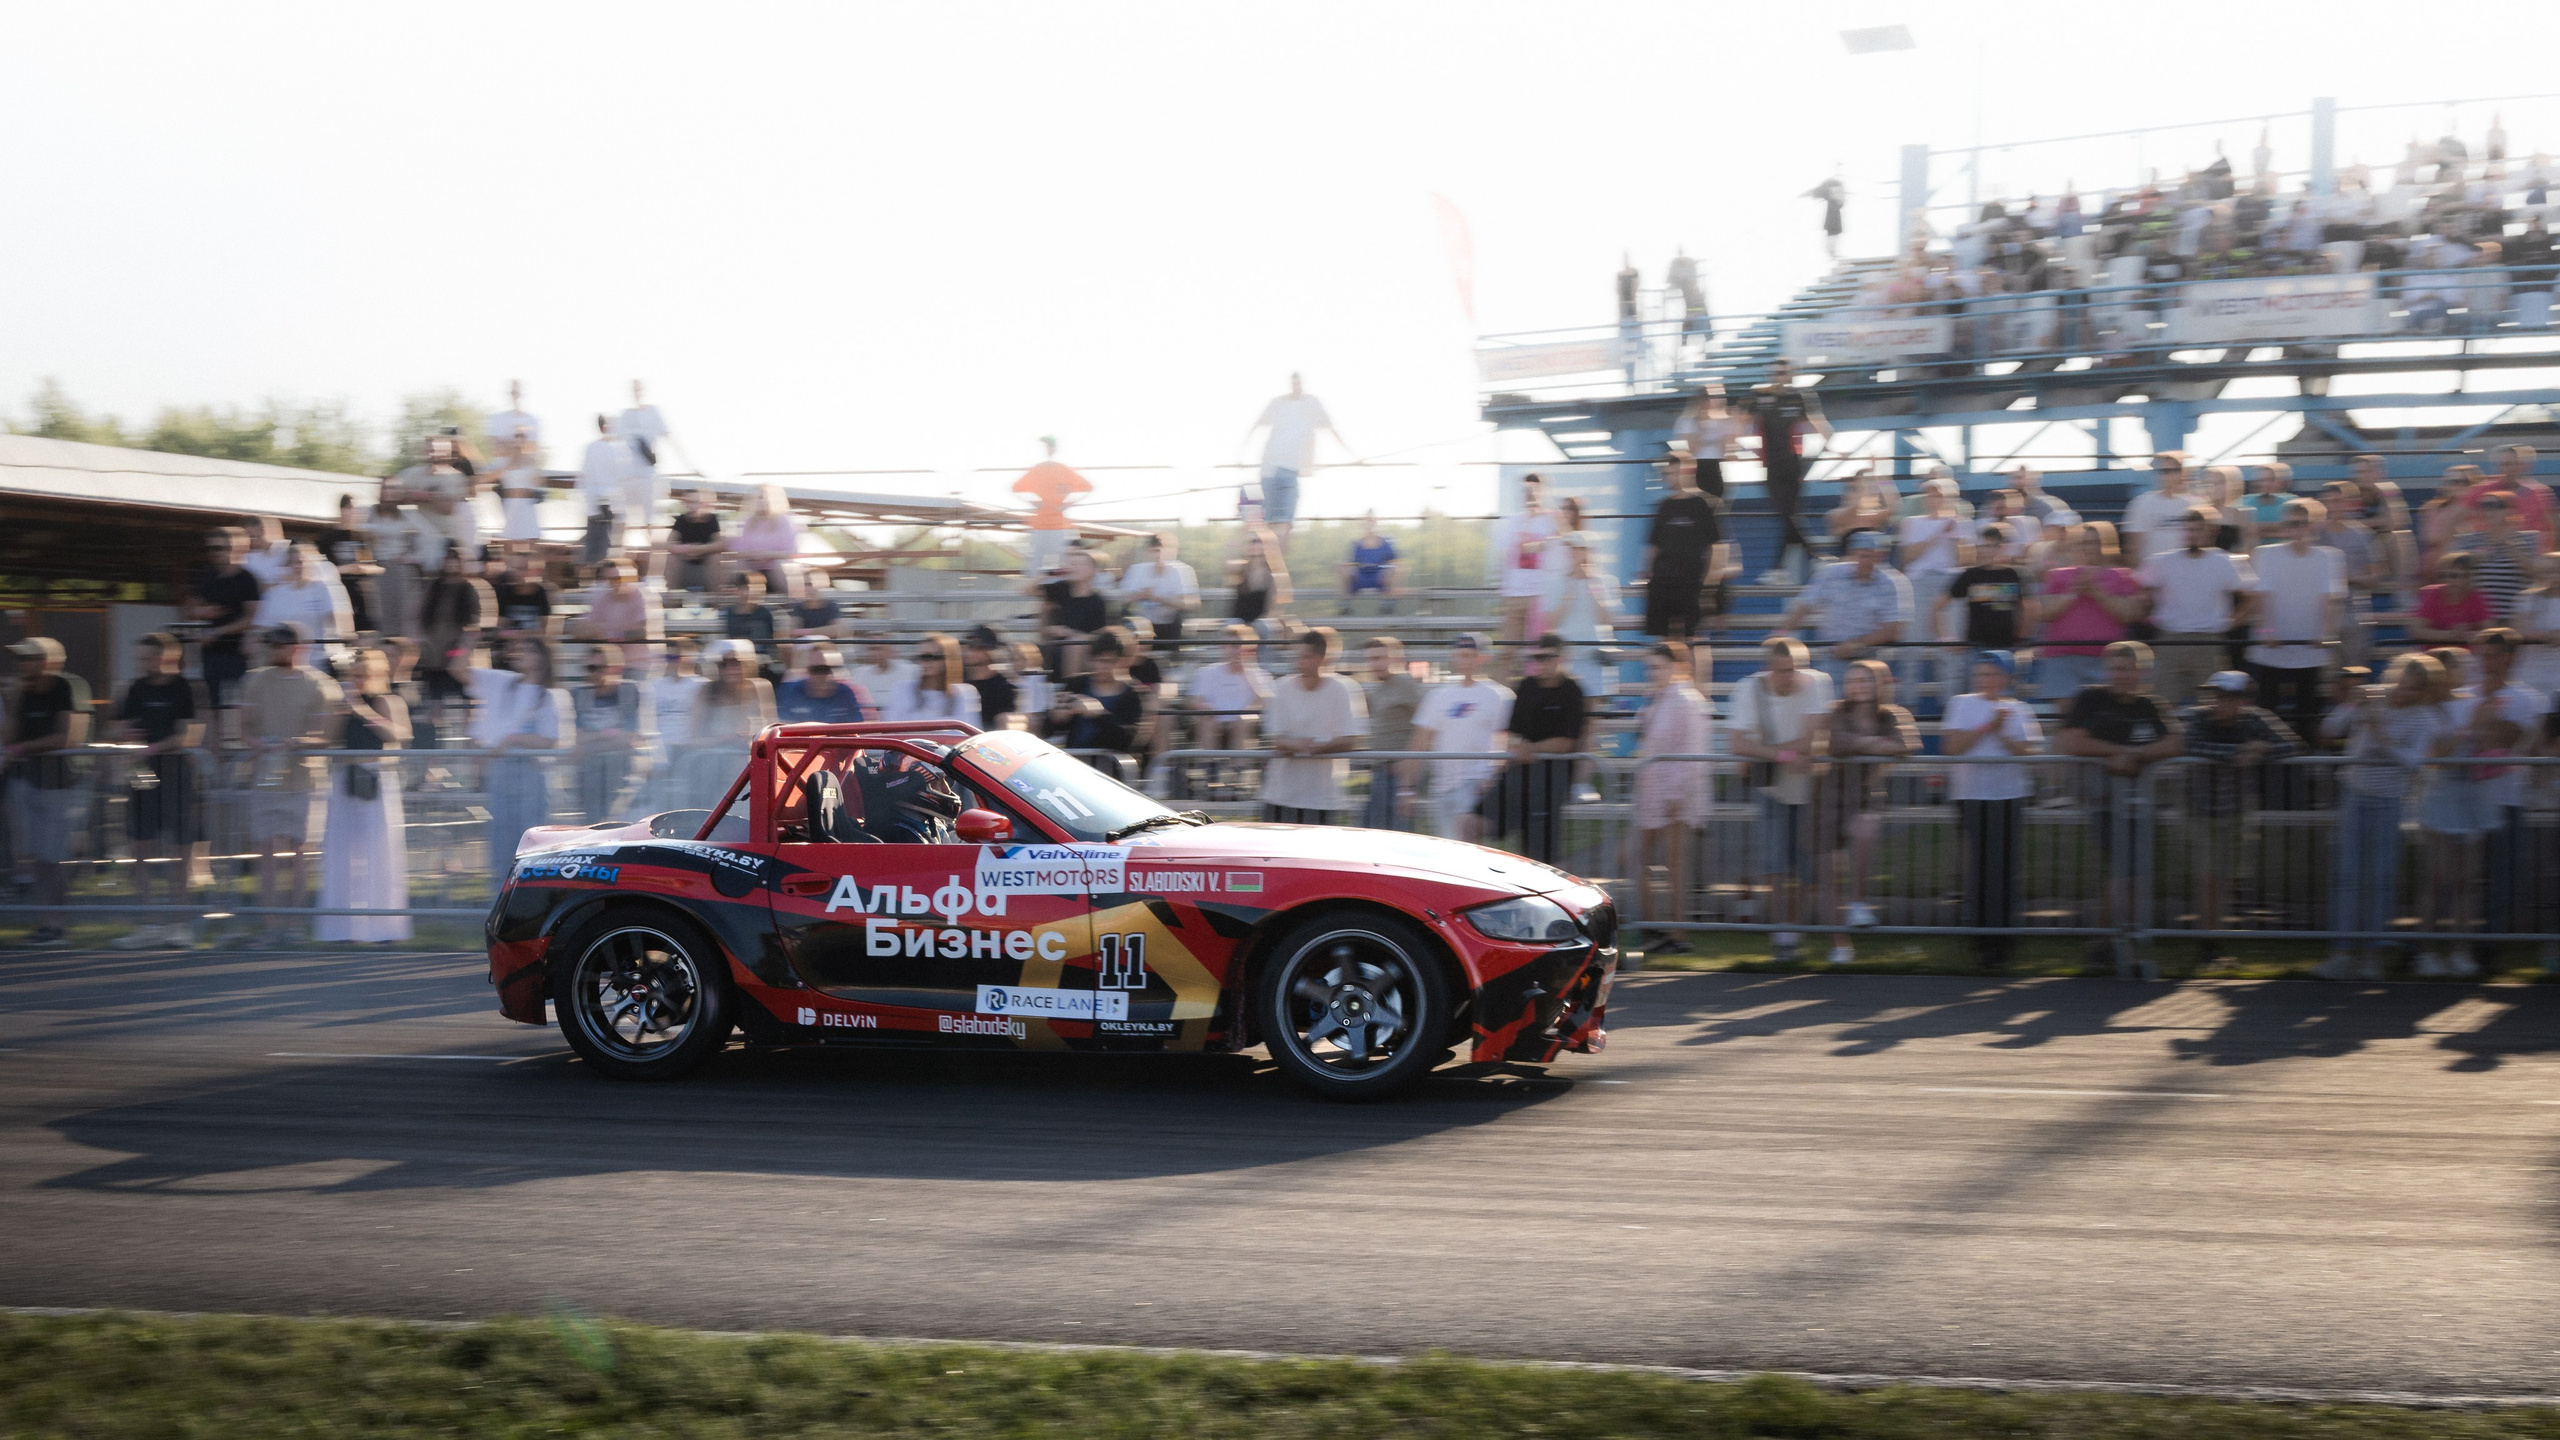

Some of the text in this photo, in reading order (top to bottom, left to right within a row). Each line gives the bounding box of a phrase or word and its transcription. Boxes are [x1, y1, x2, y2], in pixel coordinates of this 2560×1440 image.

[1036, 787, 1096, 821] 11
[1028, 849, 1120, 860] Valvoline
[981, 869, 1119, 887] WESTMOTORS
[1129, 871, 1221, 892] SLABODSKI V.
[825, 875, 1007, 925] Альфа
[866, 917, 1067, 961] Бизнес
[1098, 933, 1147, 989] 11
[1011, 994, 1104, 1011] RACE LANE
[939, 1014, 1026, 1039] @slabodsky
[1100, 1021, 1175, 1032] OKLEYKA.BY
